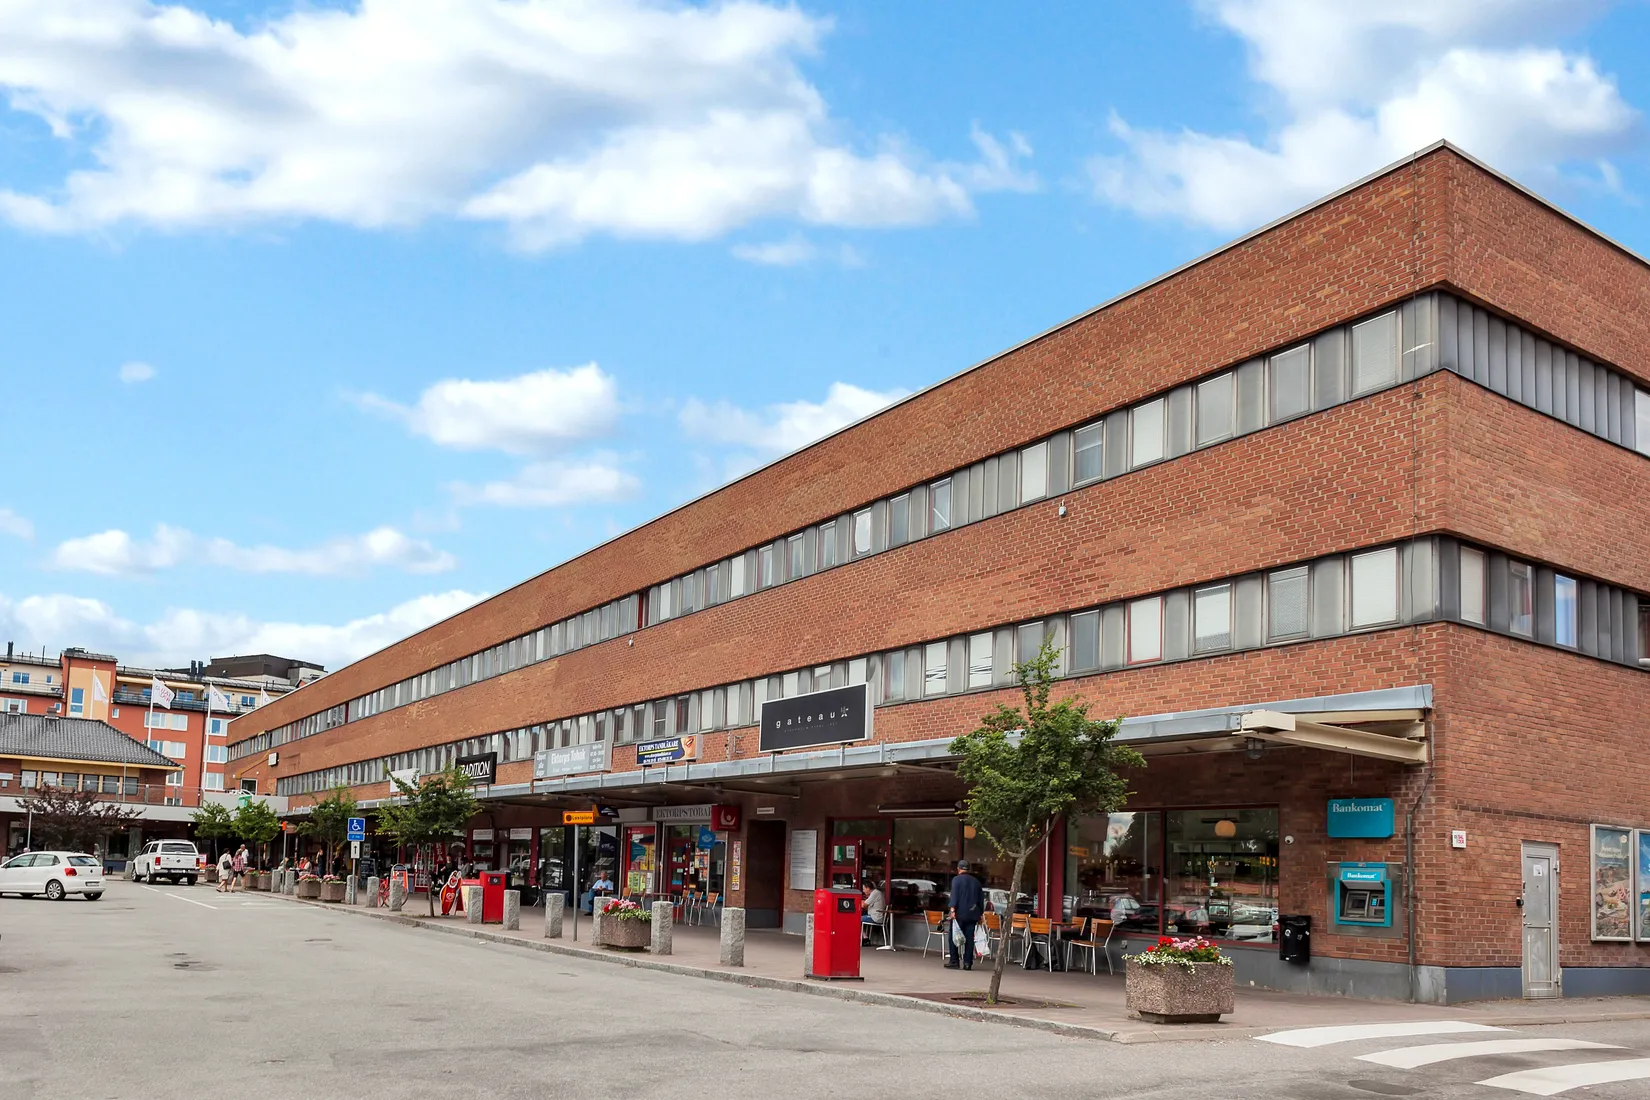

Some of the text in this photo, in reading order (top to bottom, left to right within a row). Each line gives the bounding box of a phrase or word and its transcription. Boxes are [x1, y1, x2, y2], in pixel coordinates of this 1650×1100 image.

[776, 711, 836, 729] gateau
[551, 753, 570, 764] Ektorps
[570, 748, 586, 761] Tobak
[639, 744, 654, 752] EKTORPS
[461, 760, 490, 776] RADITION
[1332, 802, 1383, 813] Bankomat
